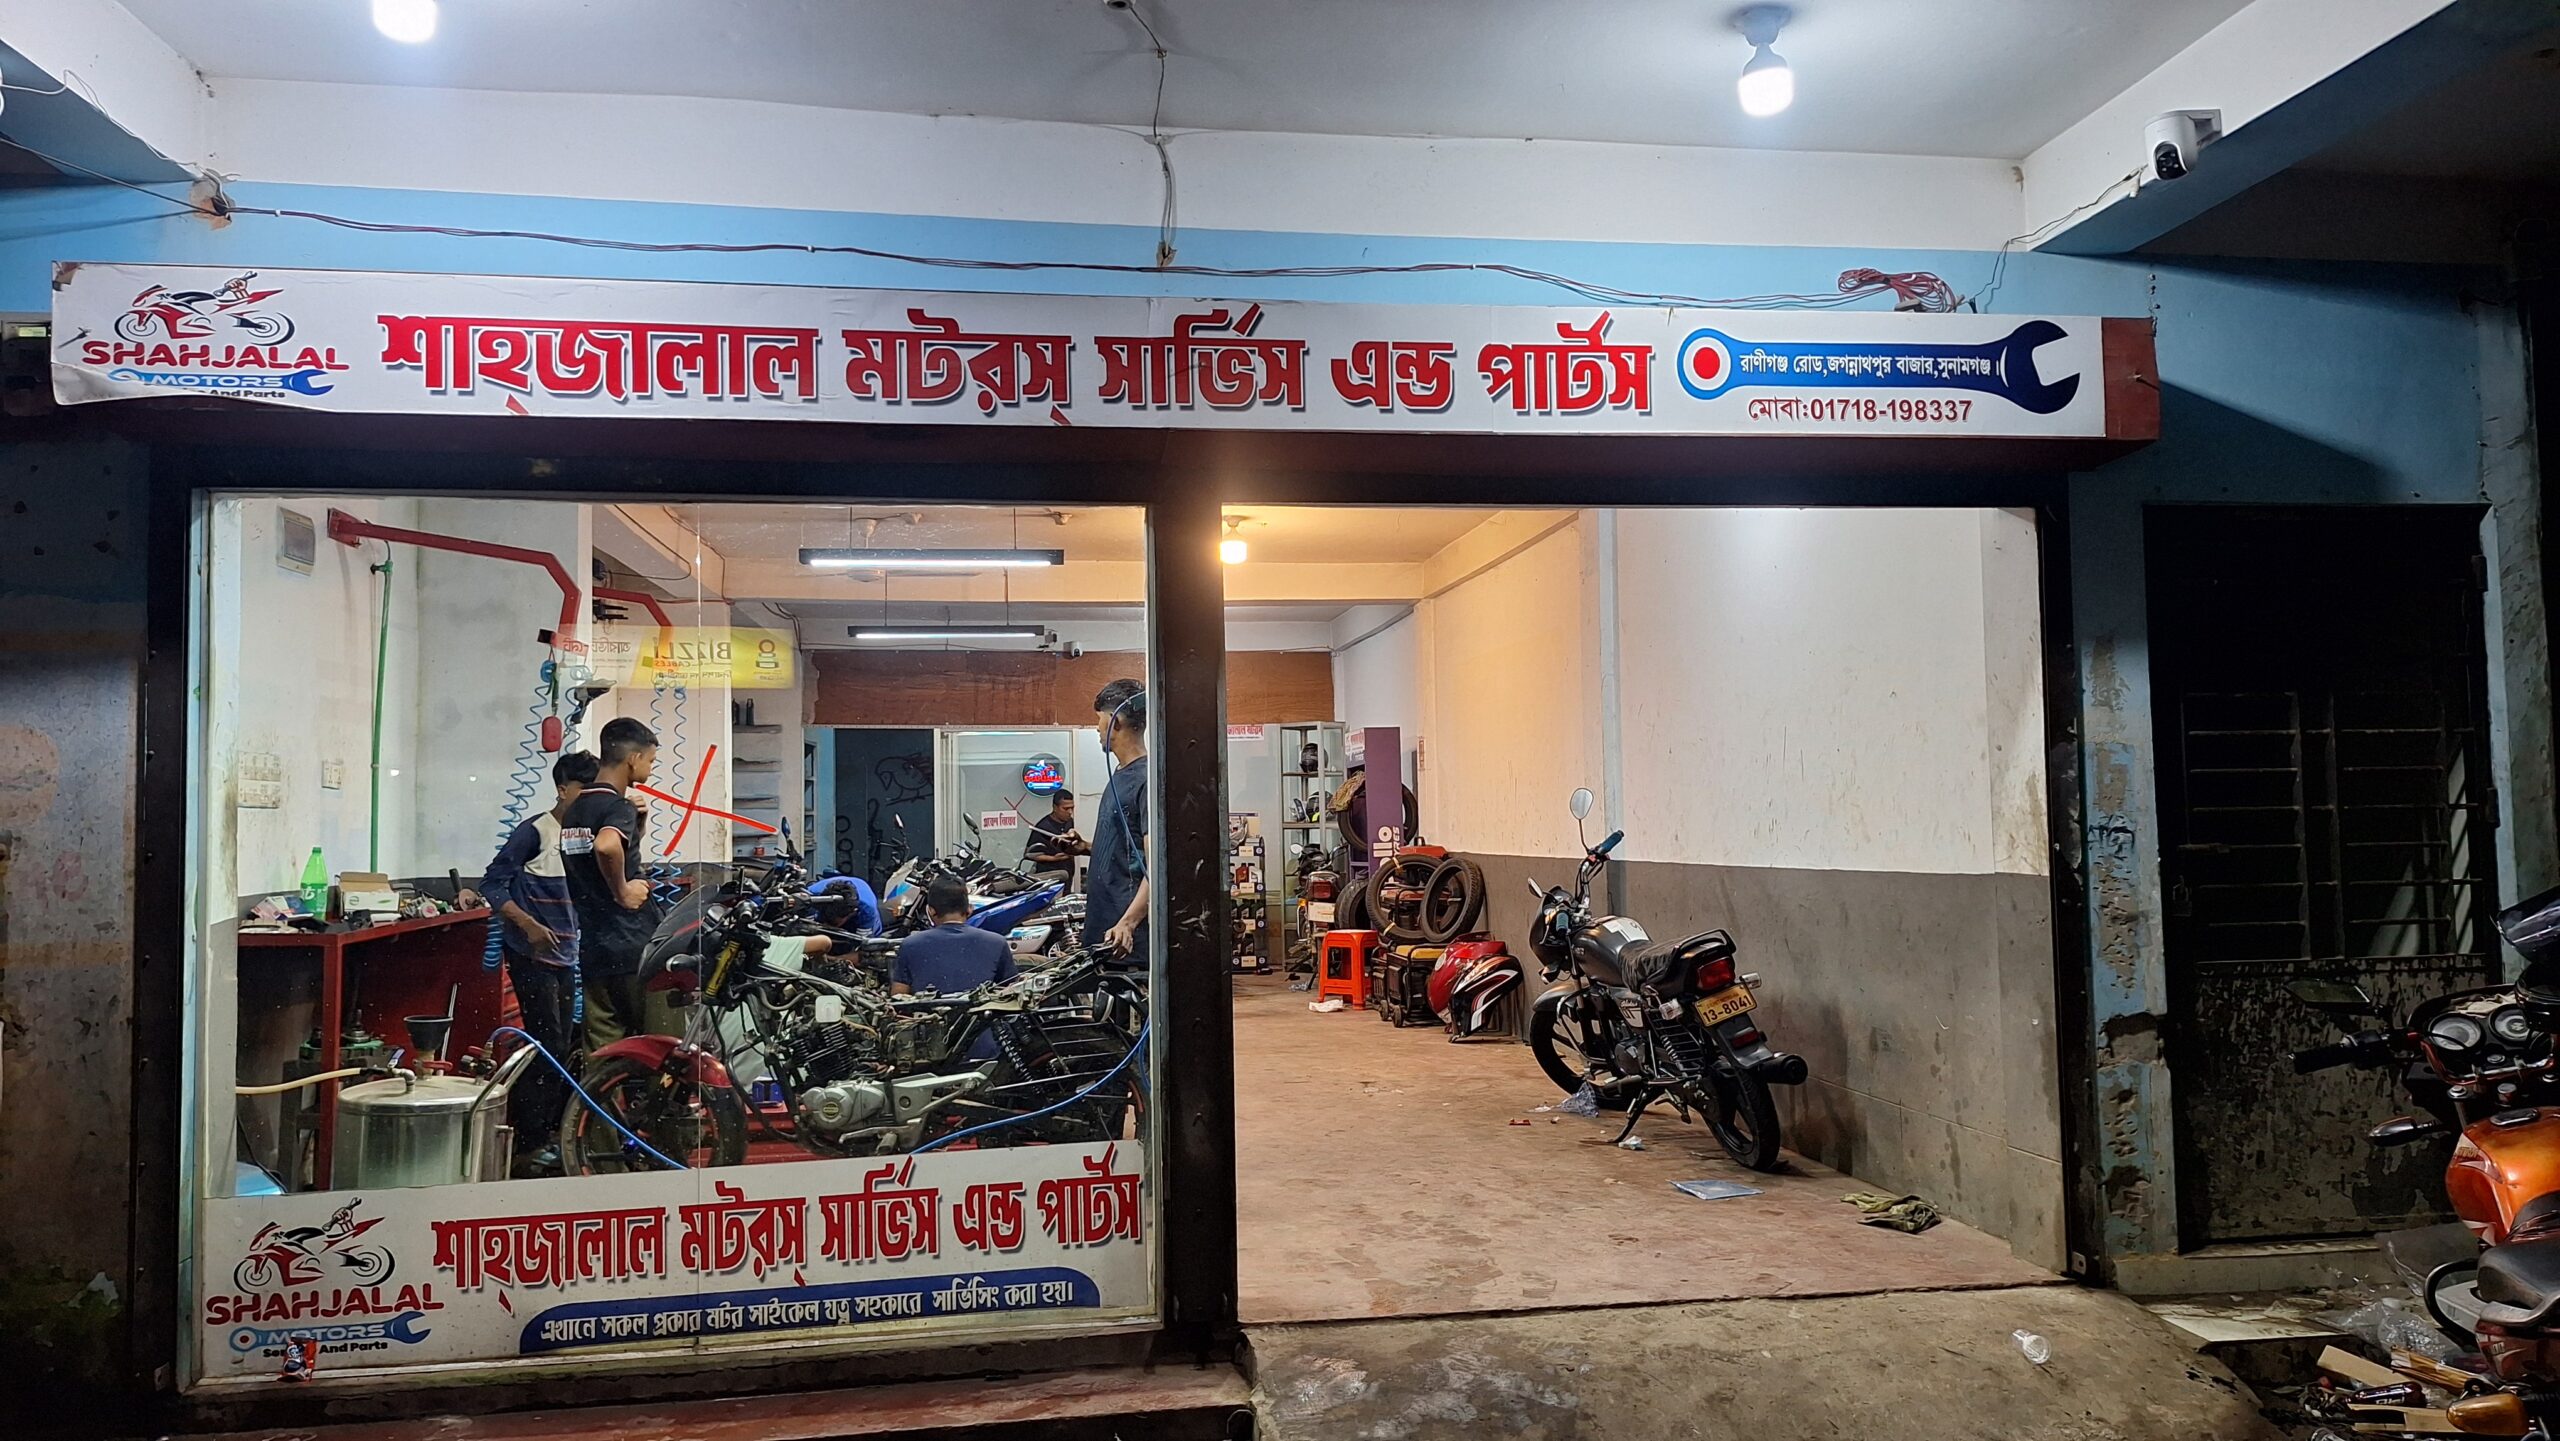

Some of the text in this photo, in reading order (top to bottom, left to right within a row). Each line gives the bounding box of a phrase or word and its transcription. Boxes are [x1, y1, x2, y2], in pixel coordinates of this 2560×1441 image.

[81, 340, 350, 370] SHAHJALAL
[1094, 302, 1307, 410] সার্ভিস
[1330, 341, 1455, 410] এন্ড
[1477, 310, 1654, 412] পার্টস
[1739, 348, 1789, 374] রাণীগঞ্জ
[151, 374, 284, 387] MOTORS
[243, 389, 286, 398] Parts
[1703, 995, 1752, 1022] 13-8041
[819, 1155, 942, 1263] সার্ভিস
[953, 1181, 1024, 1251] এন্ড
[1036, 1141, 1144, 1247] পার্টস
[206, 1282, 445, 1326] SHAHJALAL
[541, 1317, 597, 1342] এখানে
[601, 1313, 650, 1337] সকল
[653, 1309, 702, 1336] প্রকার
[705, 1301, 745, 1329] মটর
[749, 1297, 821, 1327] সাইকেল
[854, 1292, 923, 1318] সহকারে
[932, 1276, 1000, 1312] সার্ভিসিং
[1003, 1283, 1038, 1307] করা
[319, 1340, 388, 1354] And Parts
